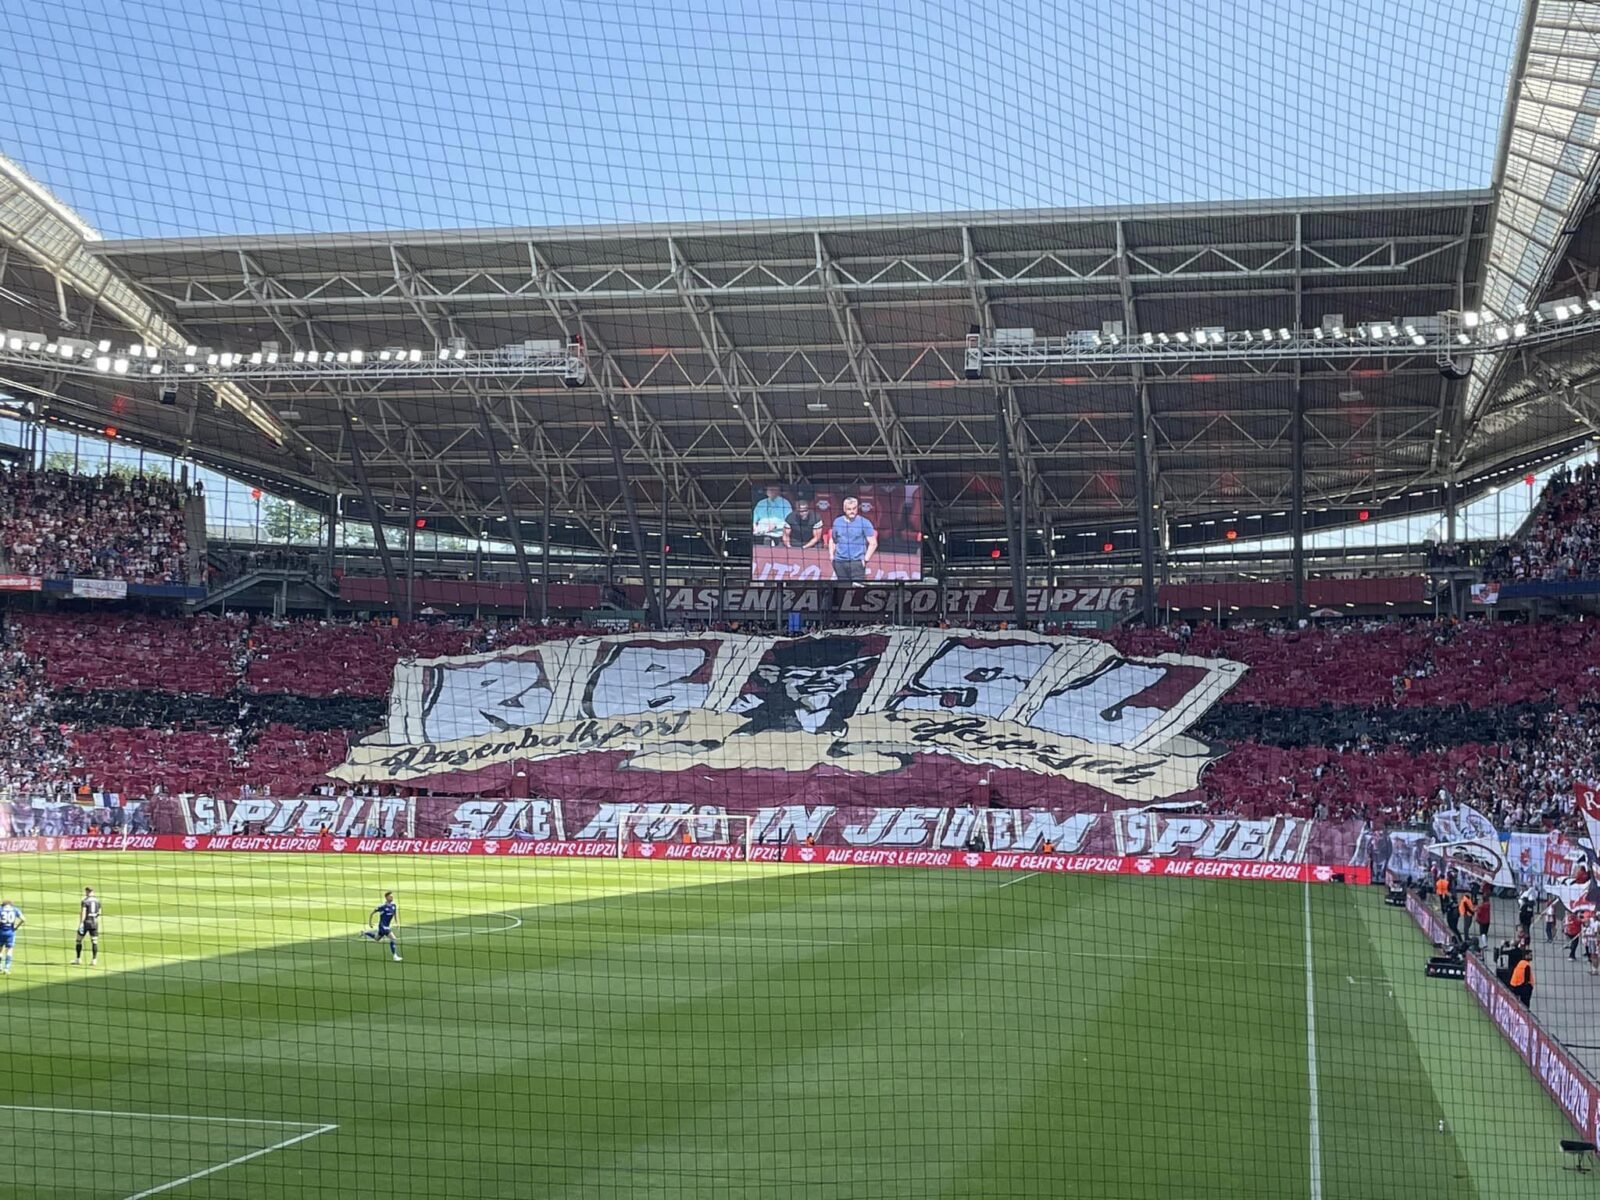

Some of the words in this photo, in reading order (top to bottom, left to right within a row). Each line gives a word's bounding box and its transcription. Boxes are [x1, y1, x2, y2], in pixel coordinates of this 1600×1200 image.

[992, 587, 1136, 613] LEIPZIG
[194, 797, 405, 838] SPIELT
[448, 801, 551, 841] SIE
[575, 803, 720, 843] AUS
[750, 806, 837, 844] IN
[842, 807, 1100, 852] JEDEM
[207, 837, 232, 849] AUF
[232, 837, 271, 849] GEHT'S
[271, 838, 321, 850] LEIPZIG!
[356, 840, 381, 852] AUF
[382, 840, 422, 852] GEHT'S
[423, 841, 472, 853] LEIPZIG!
[509, 842, 534, 854] AUF
[577, 843, 627, 856] LEIPZI!
[665, 846, 690, 858] AUF
[825, 850, 851, 862] AUF
[853, 850, 895, 864] GEHT'S
[898, 852, 952, 865] LEIPZIG!
[992, 855, 1018, 868] AUF
[1020, 856, 1066, 870] GEHT'S
[1067, 857, 1123, 872] LEIPZIG!
[1165, 862, 1195, 874] AUF
[1197, 862, 1241, 876] GEHT'S
[1242, 863, 1301, 879] LEIPZIG!
